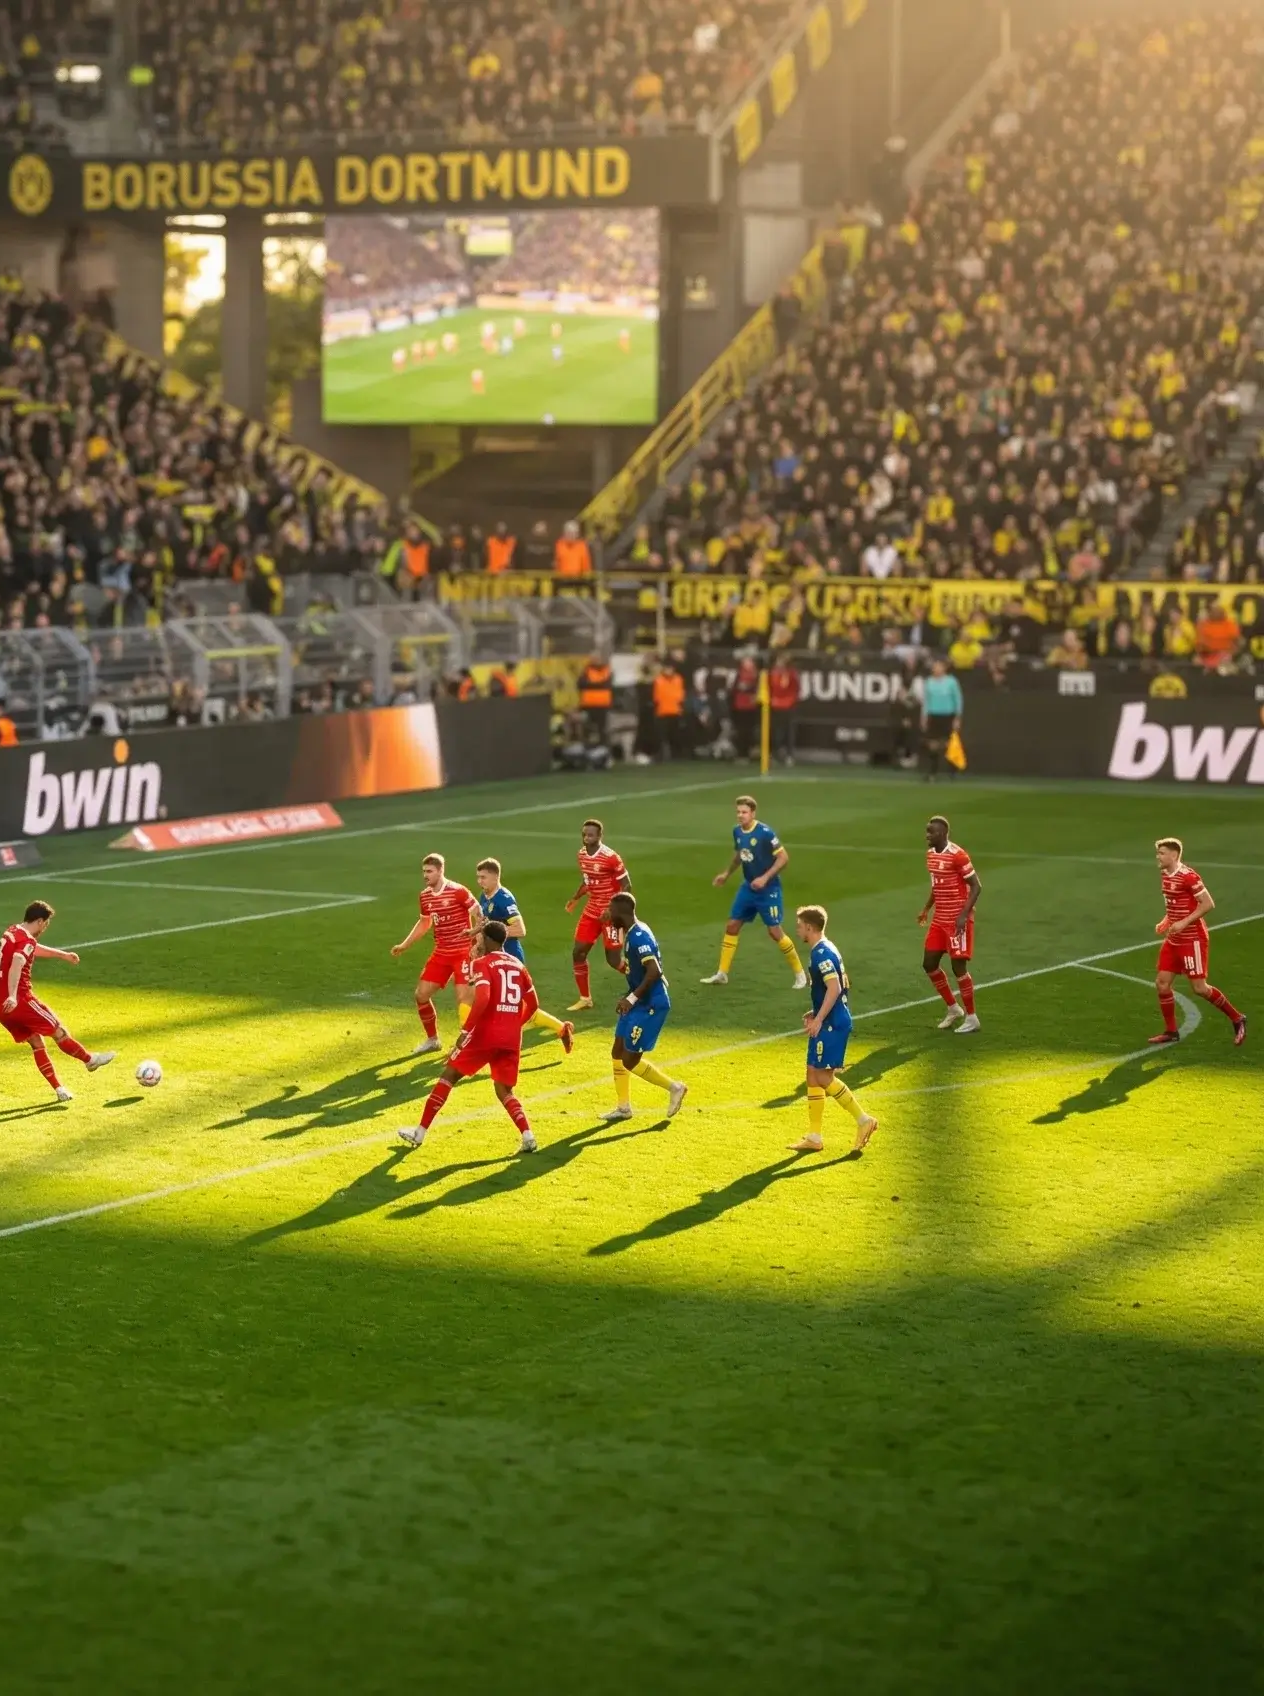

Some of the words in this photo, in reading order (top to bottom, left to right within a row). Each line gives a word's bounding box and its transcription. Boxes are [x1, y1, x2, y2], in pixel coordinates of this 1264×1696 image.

[82, 157, 323, 211] BORUSSIA
[336, 146, 631, 204] DORTMUND
[22, 738, 162, 835] bwin
[498, 968, 521, 1005] 15
